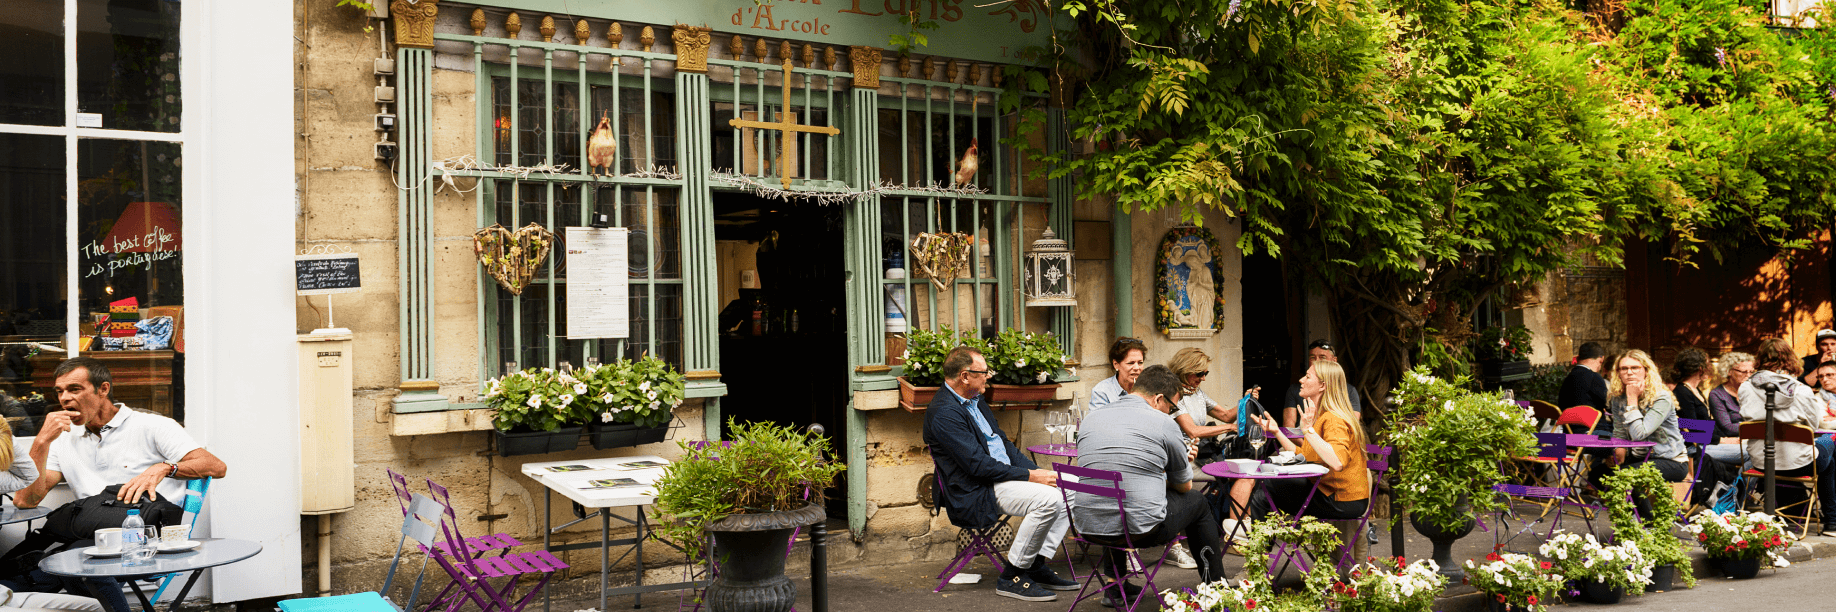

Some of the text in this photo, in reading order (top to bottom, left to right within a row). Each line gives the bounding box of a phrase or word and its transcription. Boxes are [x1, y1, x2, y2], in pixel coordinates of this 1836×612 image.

[731, 4, 831, 36] d'Arcole
[81, 239, 109, 259] The
[113, 234, 140, 254] best
[85, 262, 105, 278] is
